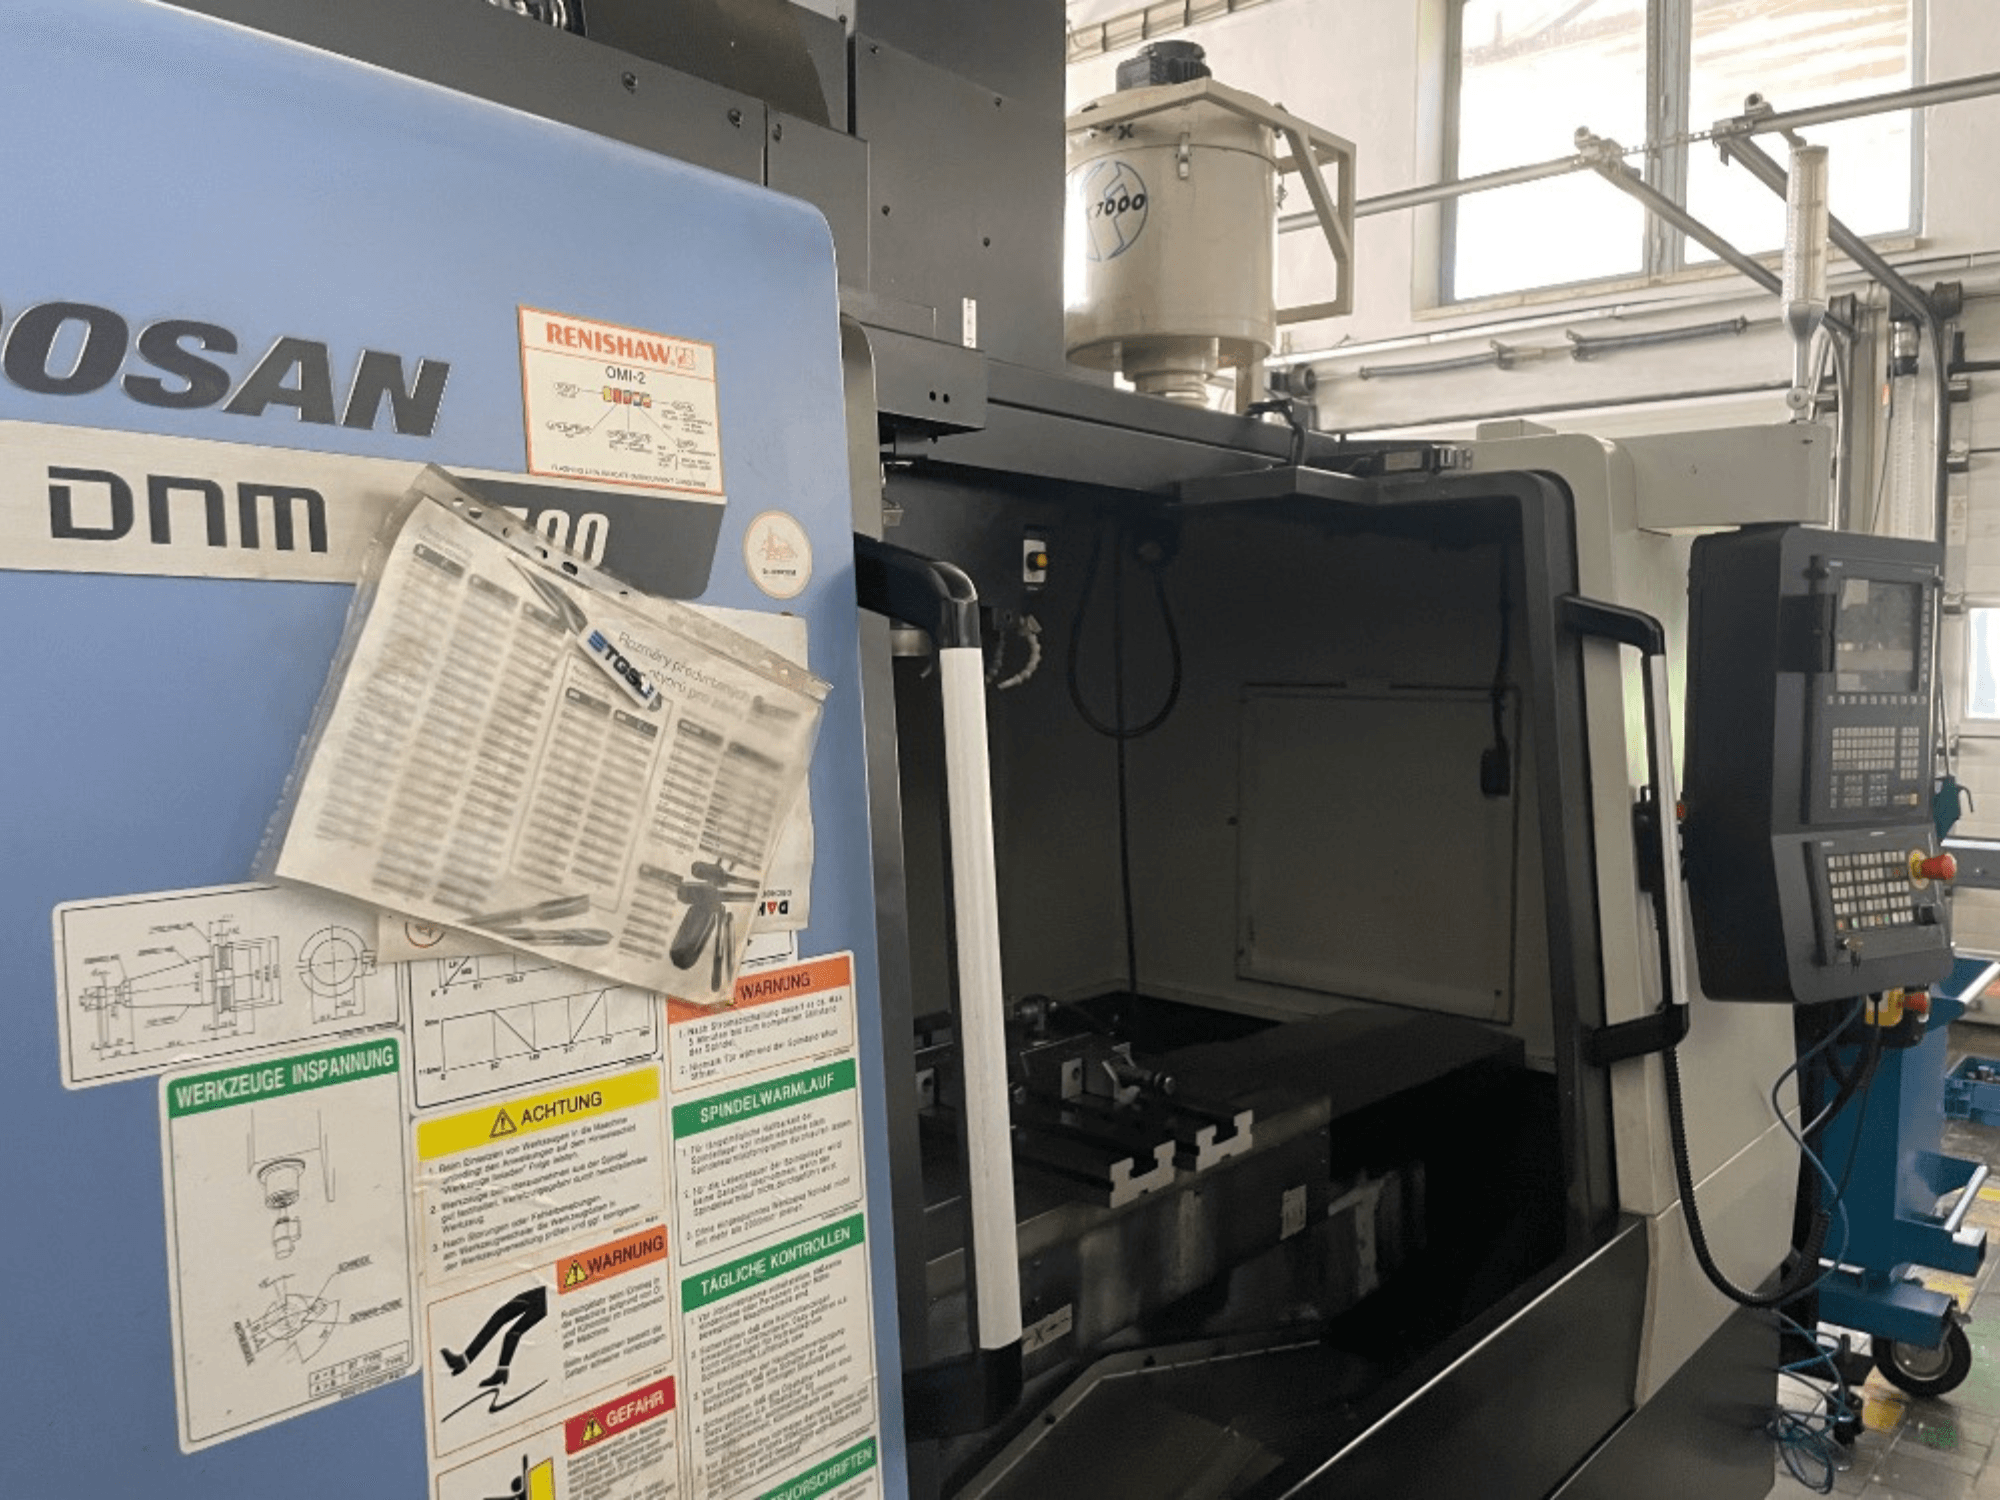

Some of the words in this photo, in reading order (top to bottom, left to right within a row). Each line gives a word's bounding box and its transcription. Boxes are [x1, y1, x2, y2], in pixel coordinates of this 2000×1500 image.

[546, 321, 670, 365] RENISHAW
[0, 301, 451, 437] OSAN
[604, 364, 647, 385] OMI-2
[740, 971, 811, 1000] WARNUNG
[175, 1067, 287, 1109] WERKZEUGE
[291, 1045, 395, 1086] INSPANNUNG
[520, 1091, 603, 1127] ACHTUNG
[701, 1072, 835, 1124] SPINDELWARMLAUF
[586, 1235, 664, 1275] WARNUNG
[770, 1226, 851, 1269] KONTROLLEN
[605, 1390, 665, 1428] GEFAHR
